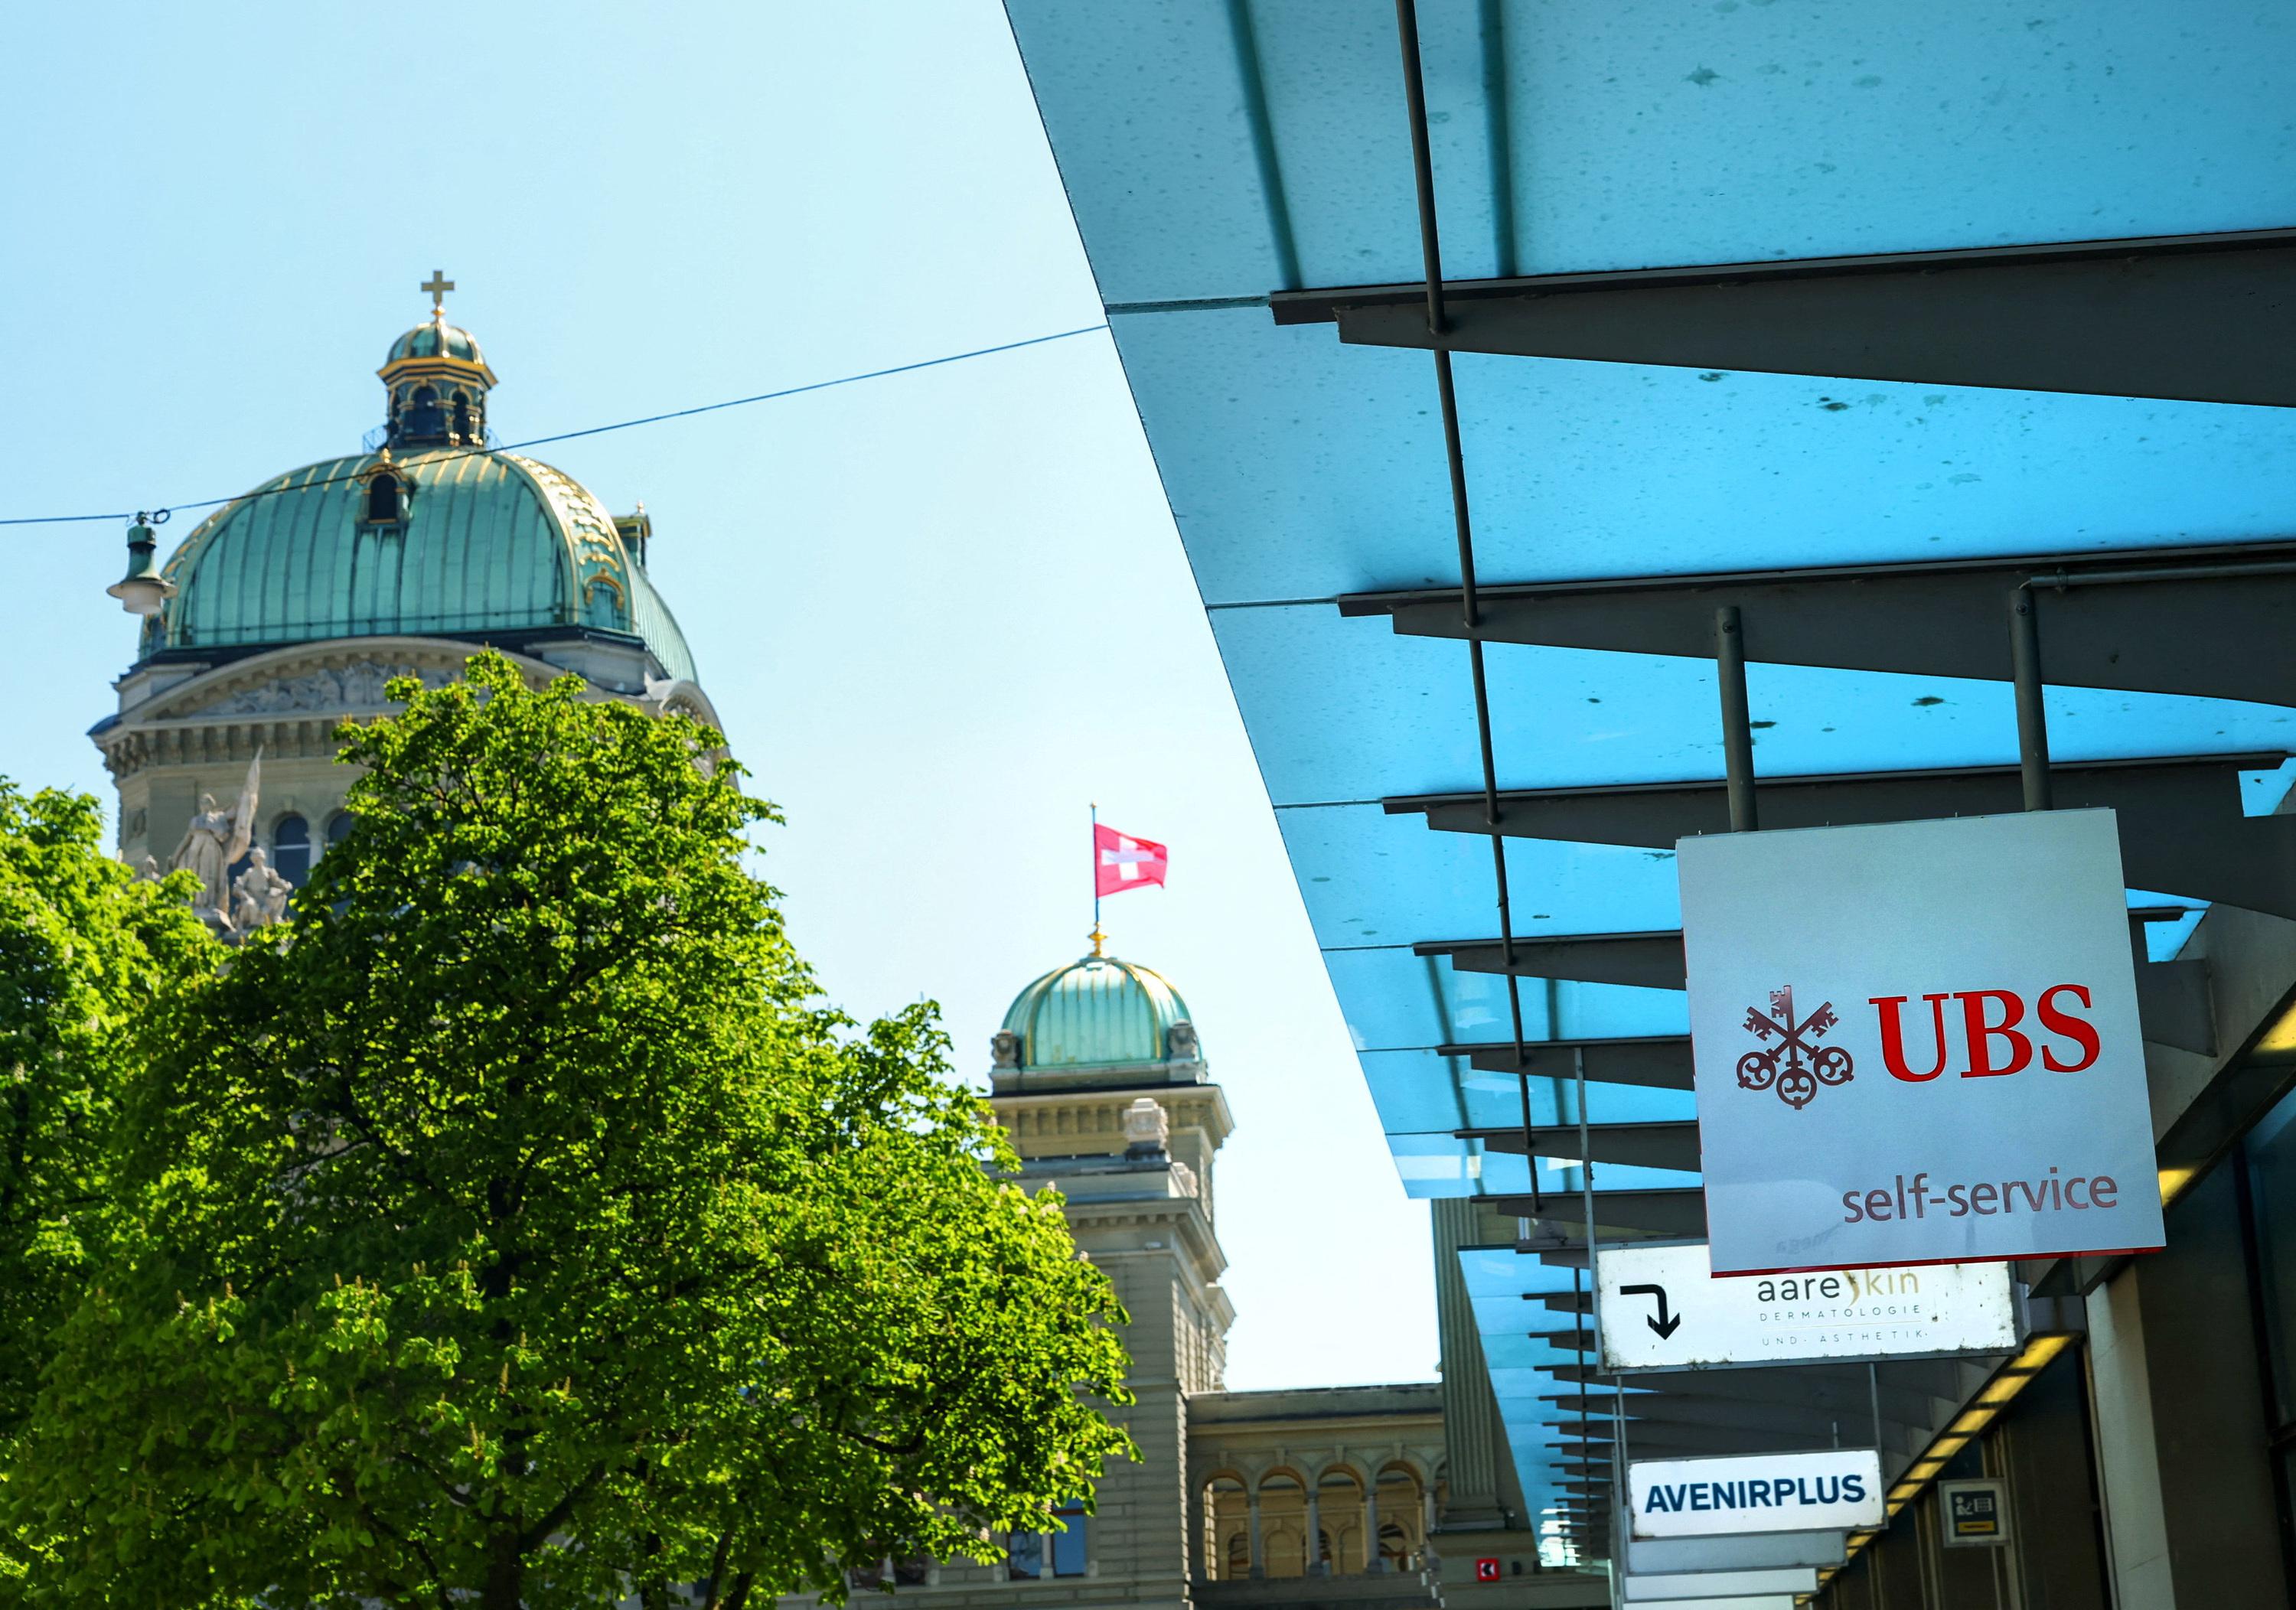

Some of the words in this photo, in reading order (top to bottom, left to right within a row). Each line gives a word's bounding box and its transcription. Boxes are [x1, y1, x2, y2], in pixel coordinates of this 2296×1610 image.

[1868, 983, 2101, 1083] UBS
[1841, 1166, 2118, 1224] self-service
[1760, 1304, 1921, 1322] DERMATOLOGIE
[1645, 1474, 1867, 1514] AVENIRPLUS
